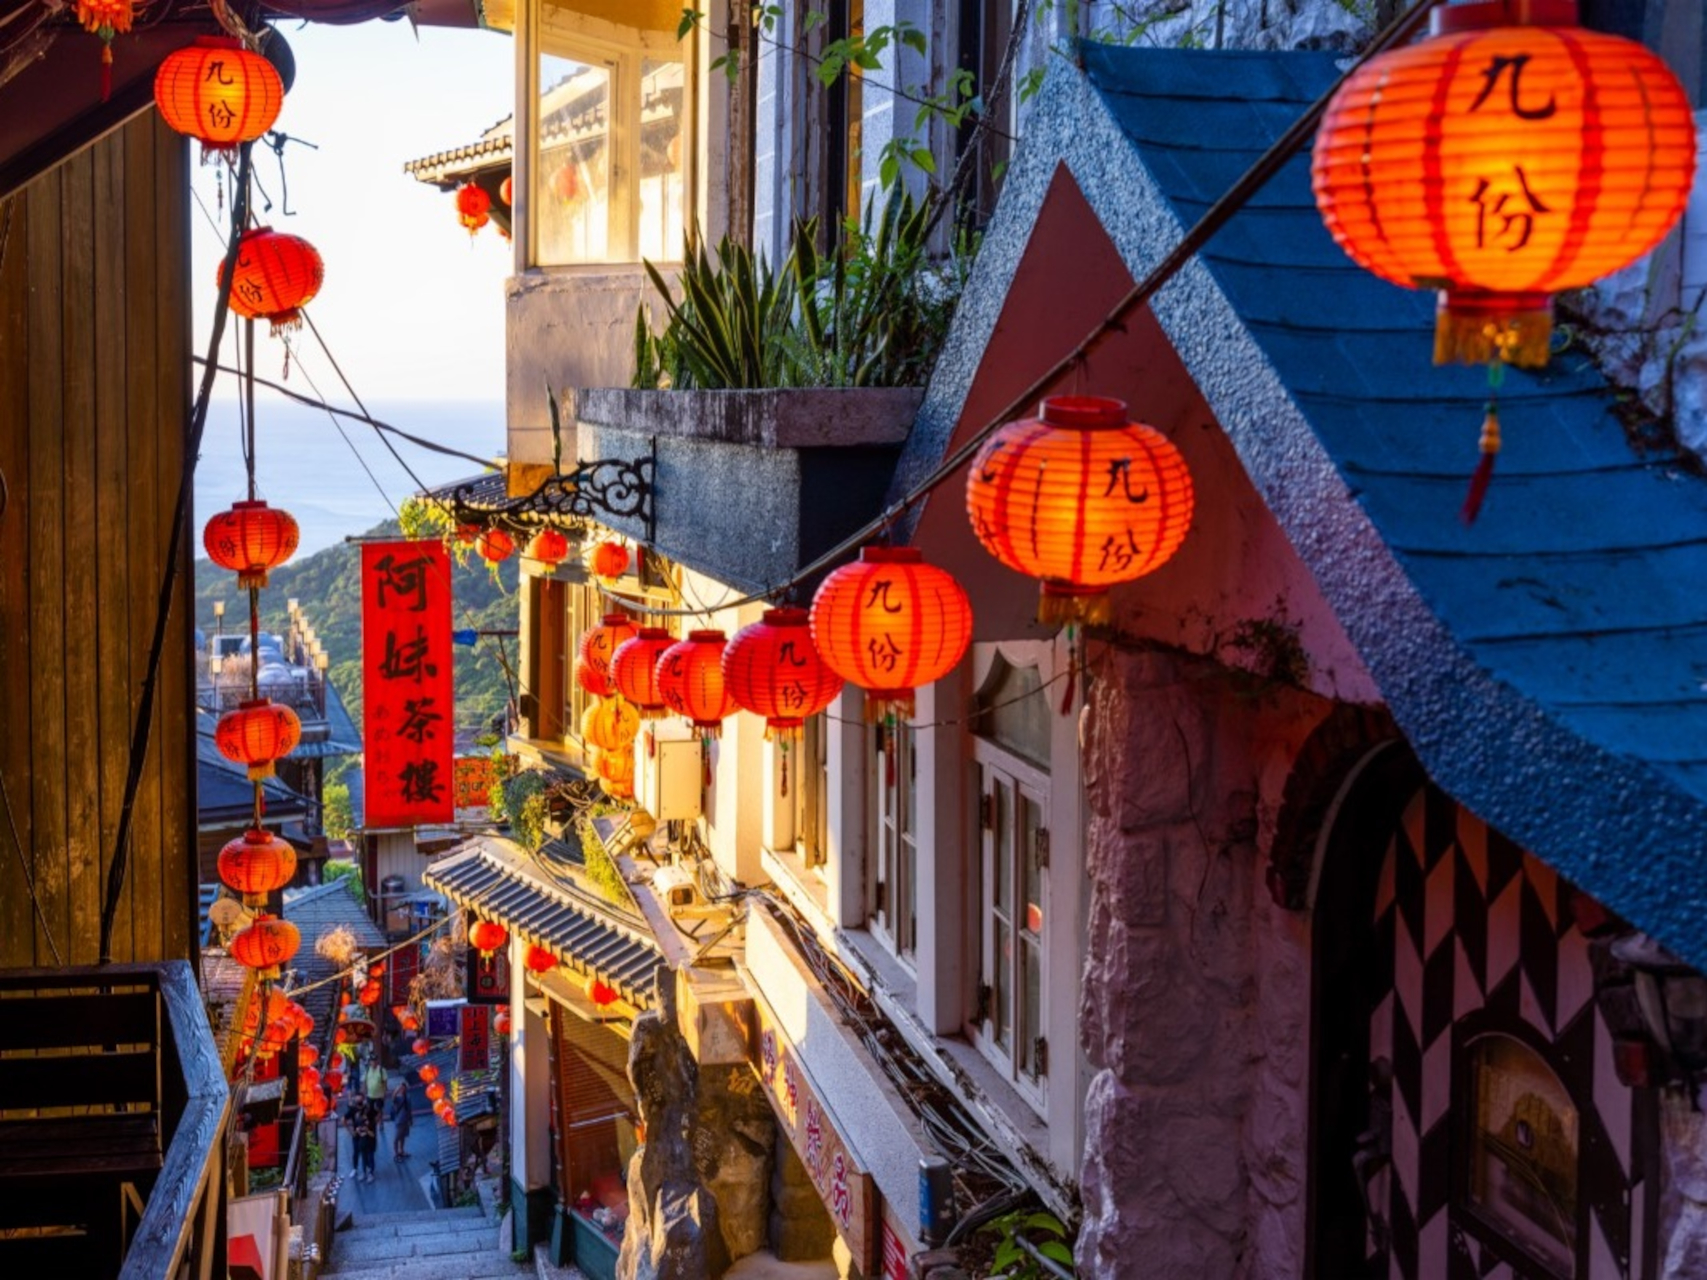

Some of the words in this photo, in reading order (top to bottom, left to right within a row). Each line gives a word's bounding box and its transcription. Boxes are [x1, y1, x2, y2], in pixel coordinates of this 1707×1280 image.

[204, 60, 236, 129] 九份
[1468, 53, 1556, 252] 九份
[1099, 456, 1148, 574] 九份
[373, 554, 446, 804] 阿妹茶樓
[779, 640, 807, 710] 九份
[866, 579, 902, 673] 九份
